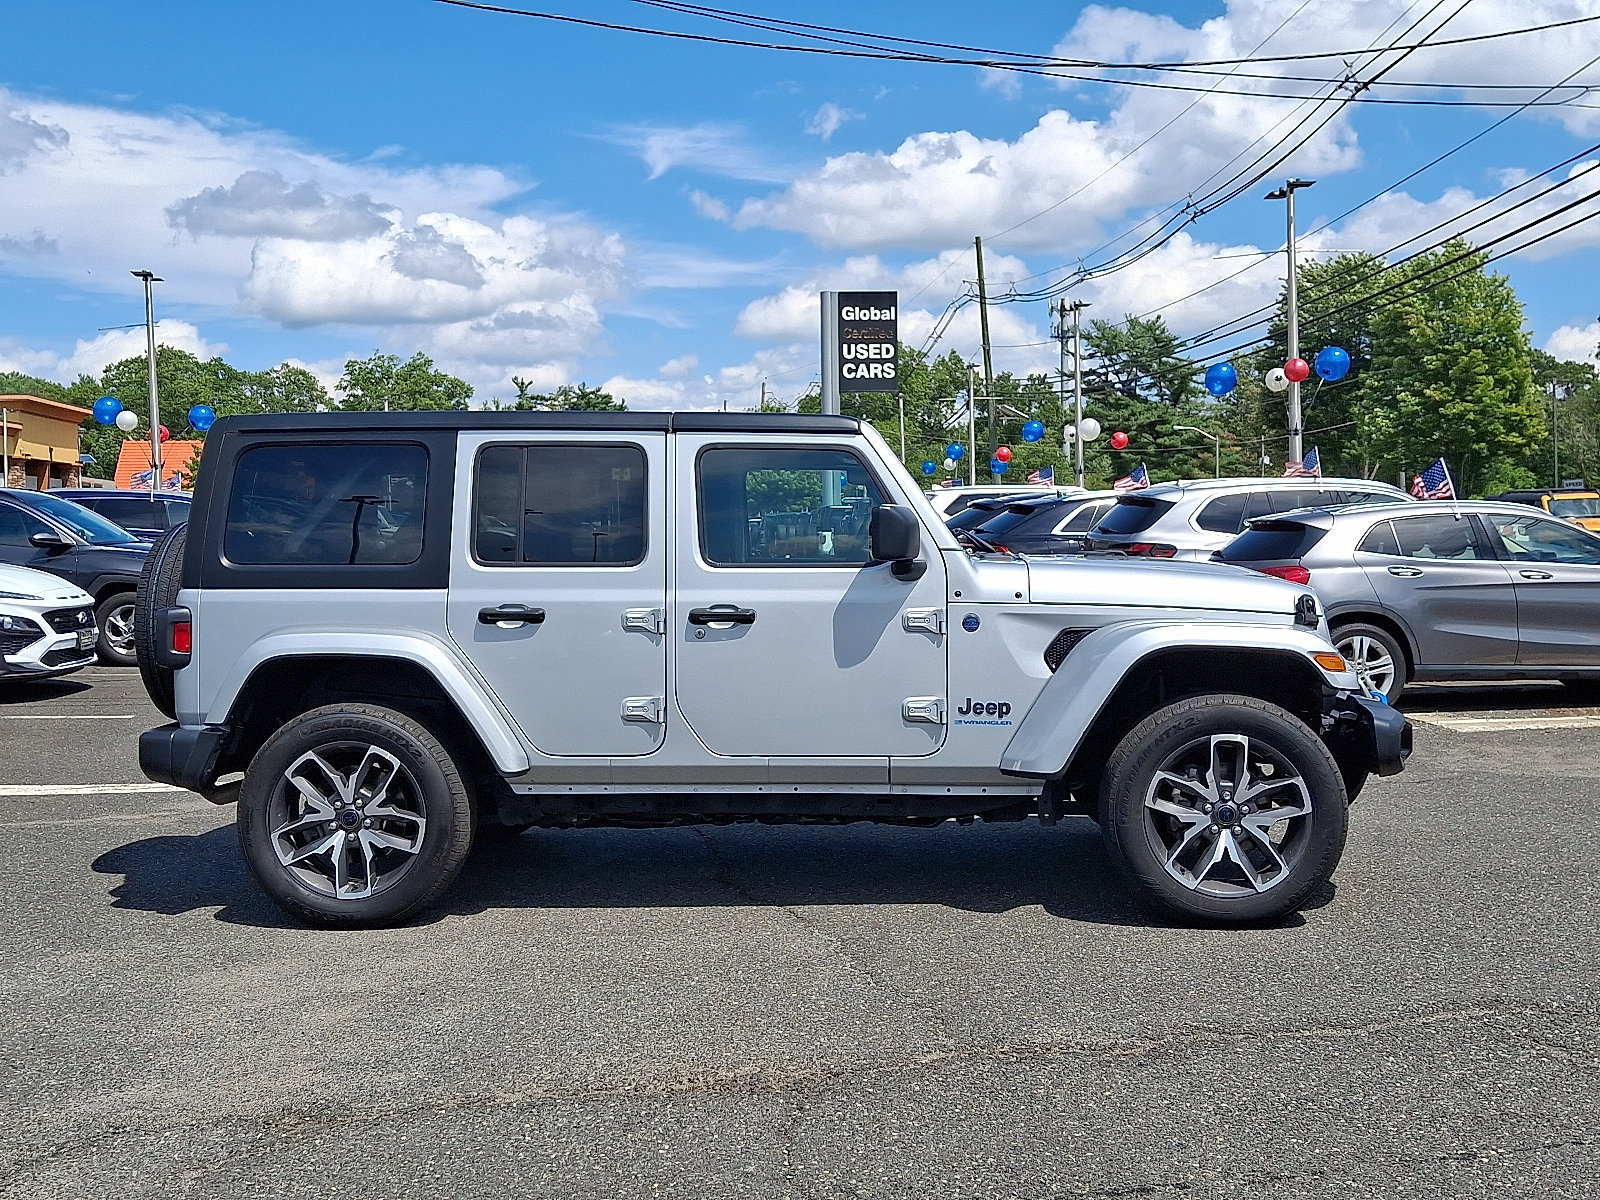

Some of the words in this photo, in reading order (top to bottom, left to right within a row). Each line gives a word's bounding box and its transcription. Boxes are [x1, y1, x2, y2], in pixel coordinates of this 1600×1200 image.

[842, 306, 895, 321] Global
[843, 343, 895, 359] USED
[843, 362, 896, 379] CARS
[957, 698, 1012, 719] Jeep
